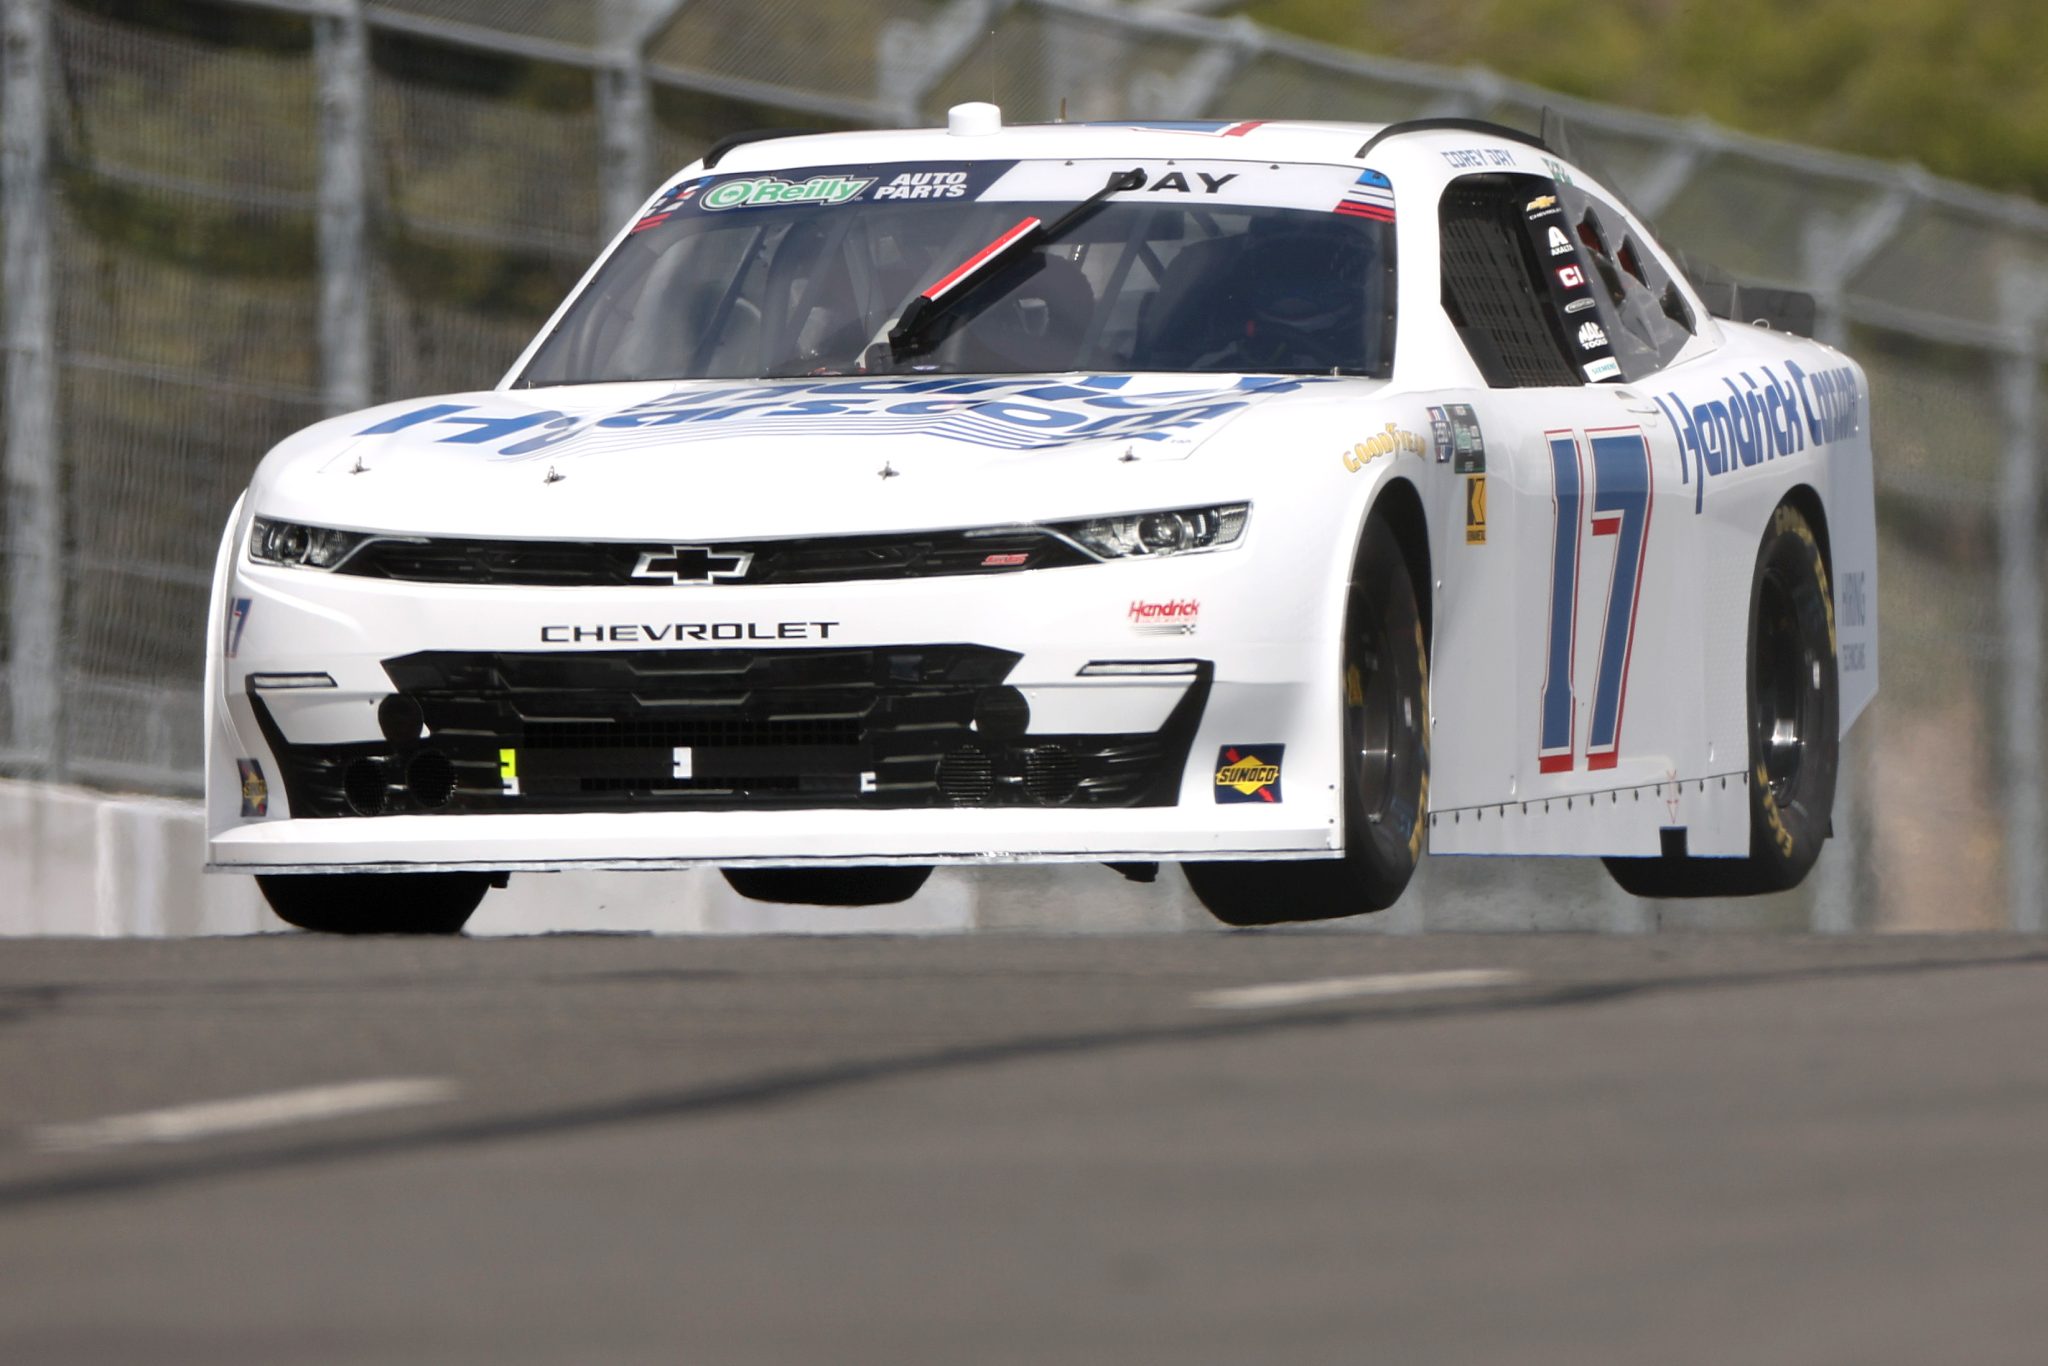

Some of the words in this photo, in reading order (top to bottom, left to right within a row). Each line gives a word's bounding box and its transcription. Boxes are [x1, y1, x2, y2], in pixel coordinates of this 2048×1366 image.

[1440, 149, 1488, 169] COREY
[1483, 148, 1517, 167] DAY
[889, 171, 968, 187] AUTO
[702, 176, 876, 210] O'Reilly
[873, 181, 968, 200] PARTS
[1578, 321, 1605, 344] MAC
[1582, 338, 1609, 351] TOOLS
[1652, 366, 1804, 515] Hendrick
[1128, 599, 1200, 623] Hendrick
[1538, 425, 1654, 775] 17
[224, 597, 253, 659] 17
[541, 621, 840, 643] CHEVROLET
[1217, 767, 1277, 783] SUNOCO
